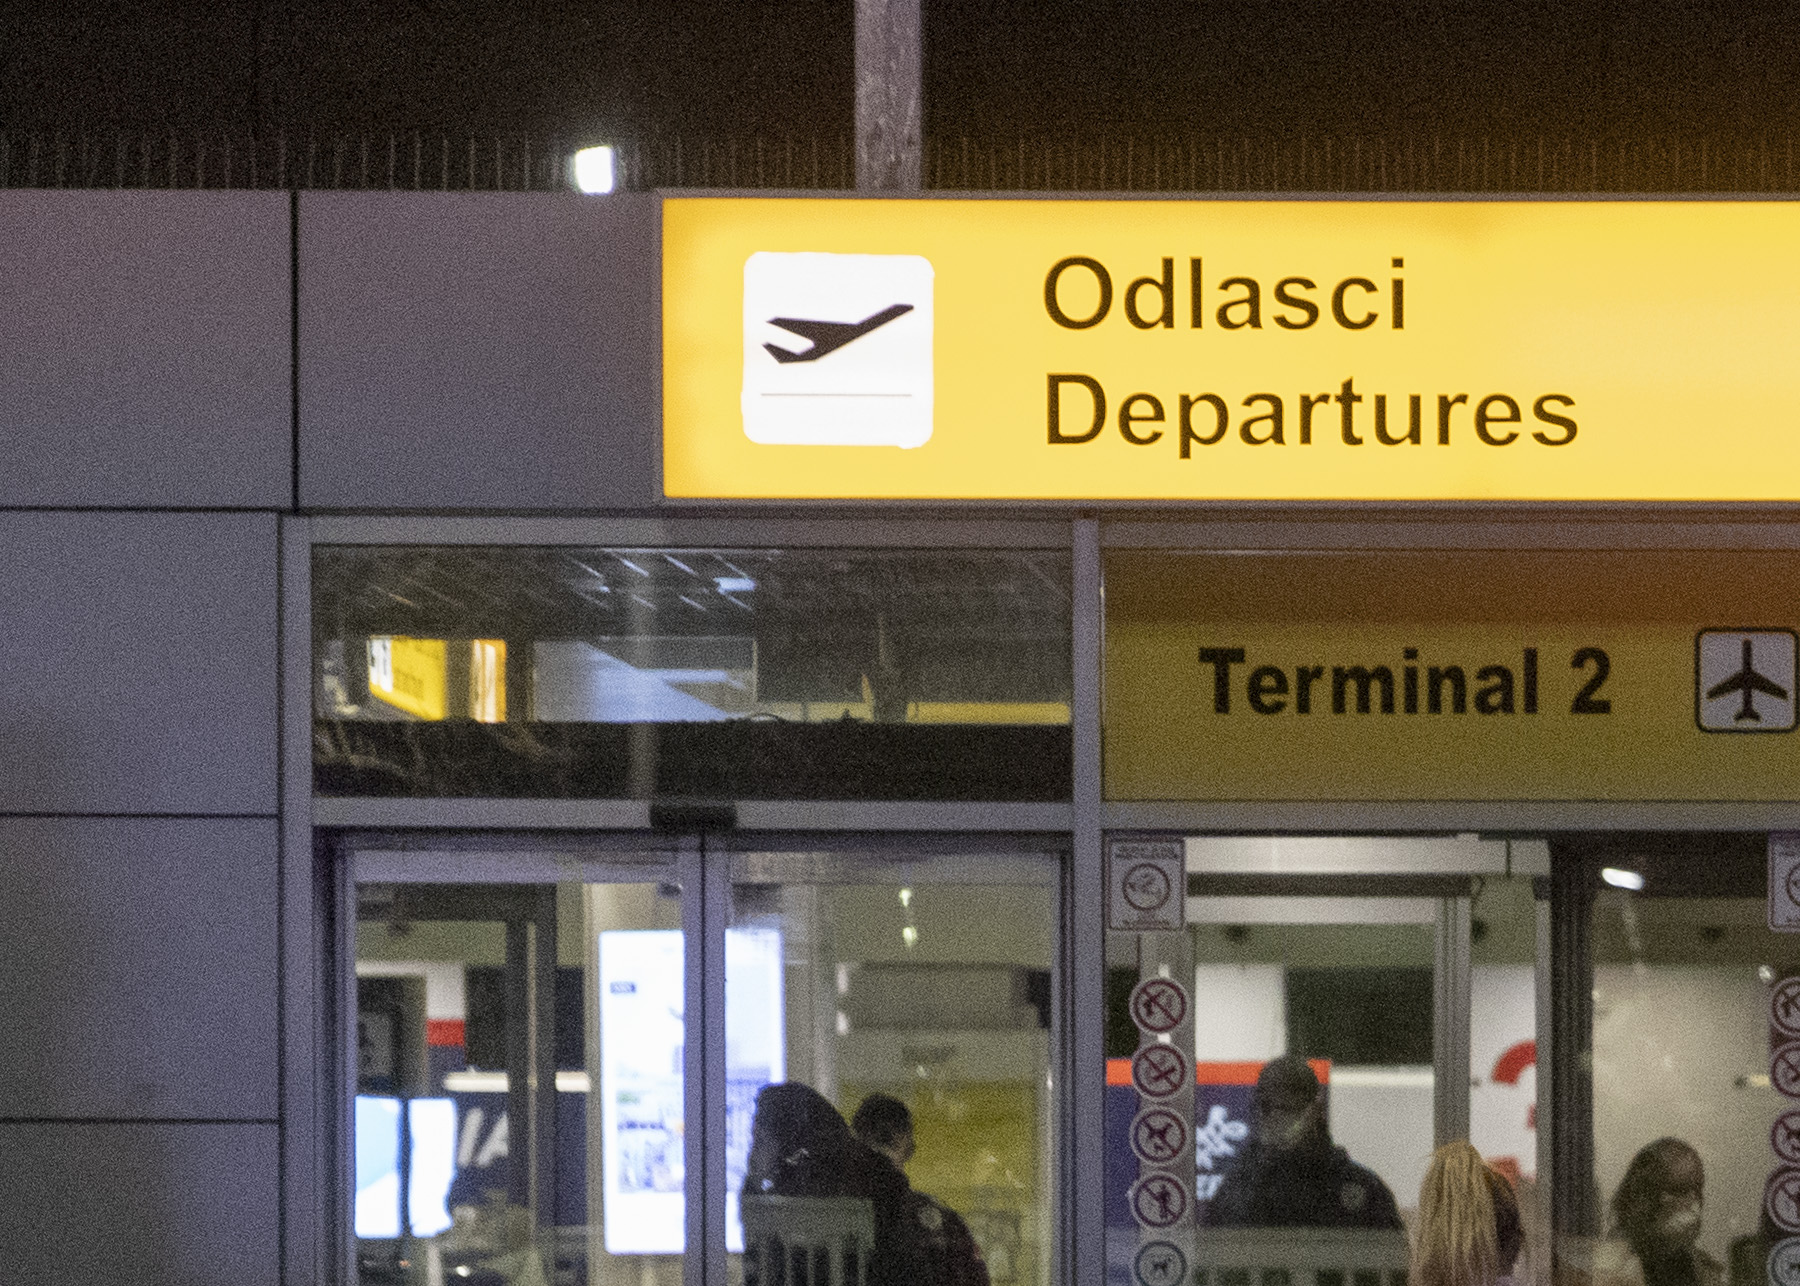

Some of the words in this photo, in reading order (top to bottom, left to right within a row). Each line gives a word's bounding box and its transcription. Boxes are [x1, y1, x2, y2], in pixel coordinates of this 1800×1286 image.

[1043, 254, 1405, 331] Odlasci
[1046, 372, 1580, 460] Departures
[1199, 646, 1539, 715] Terminal
[1570, 646, 1612, 715] 2
